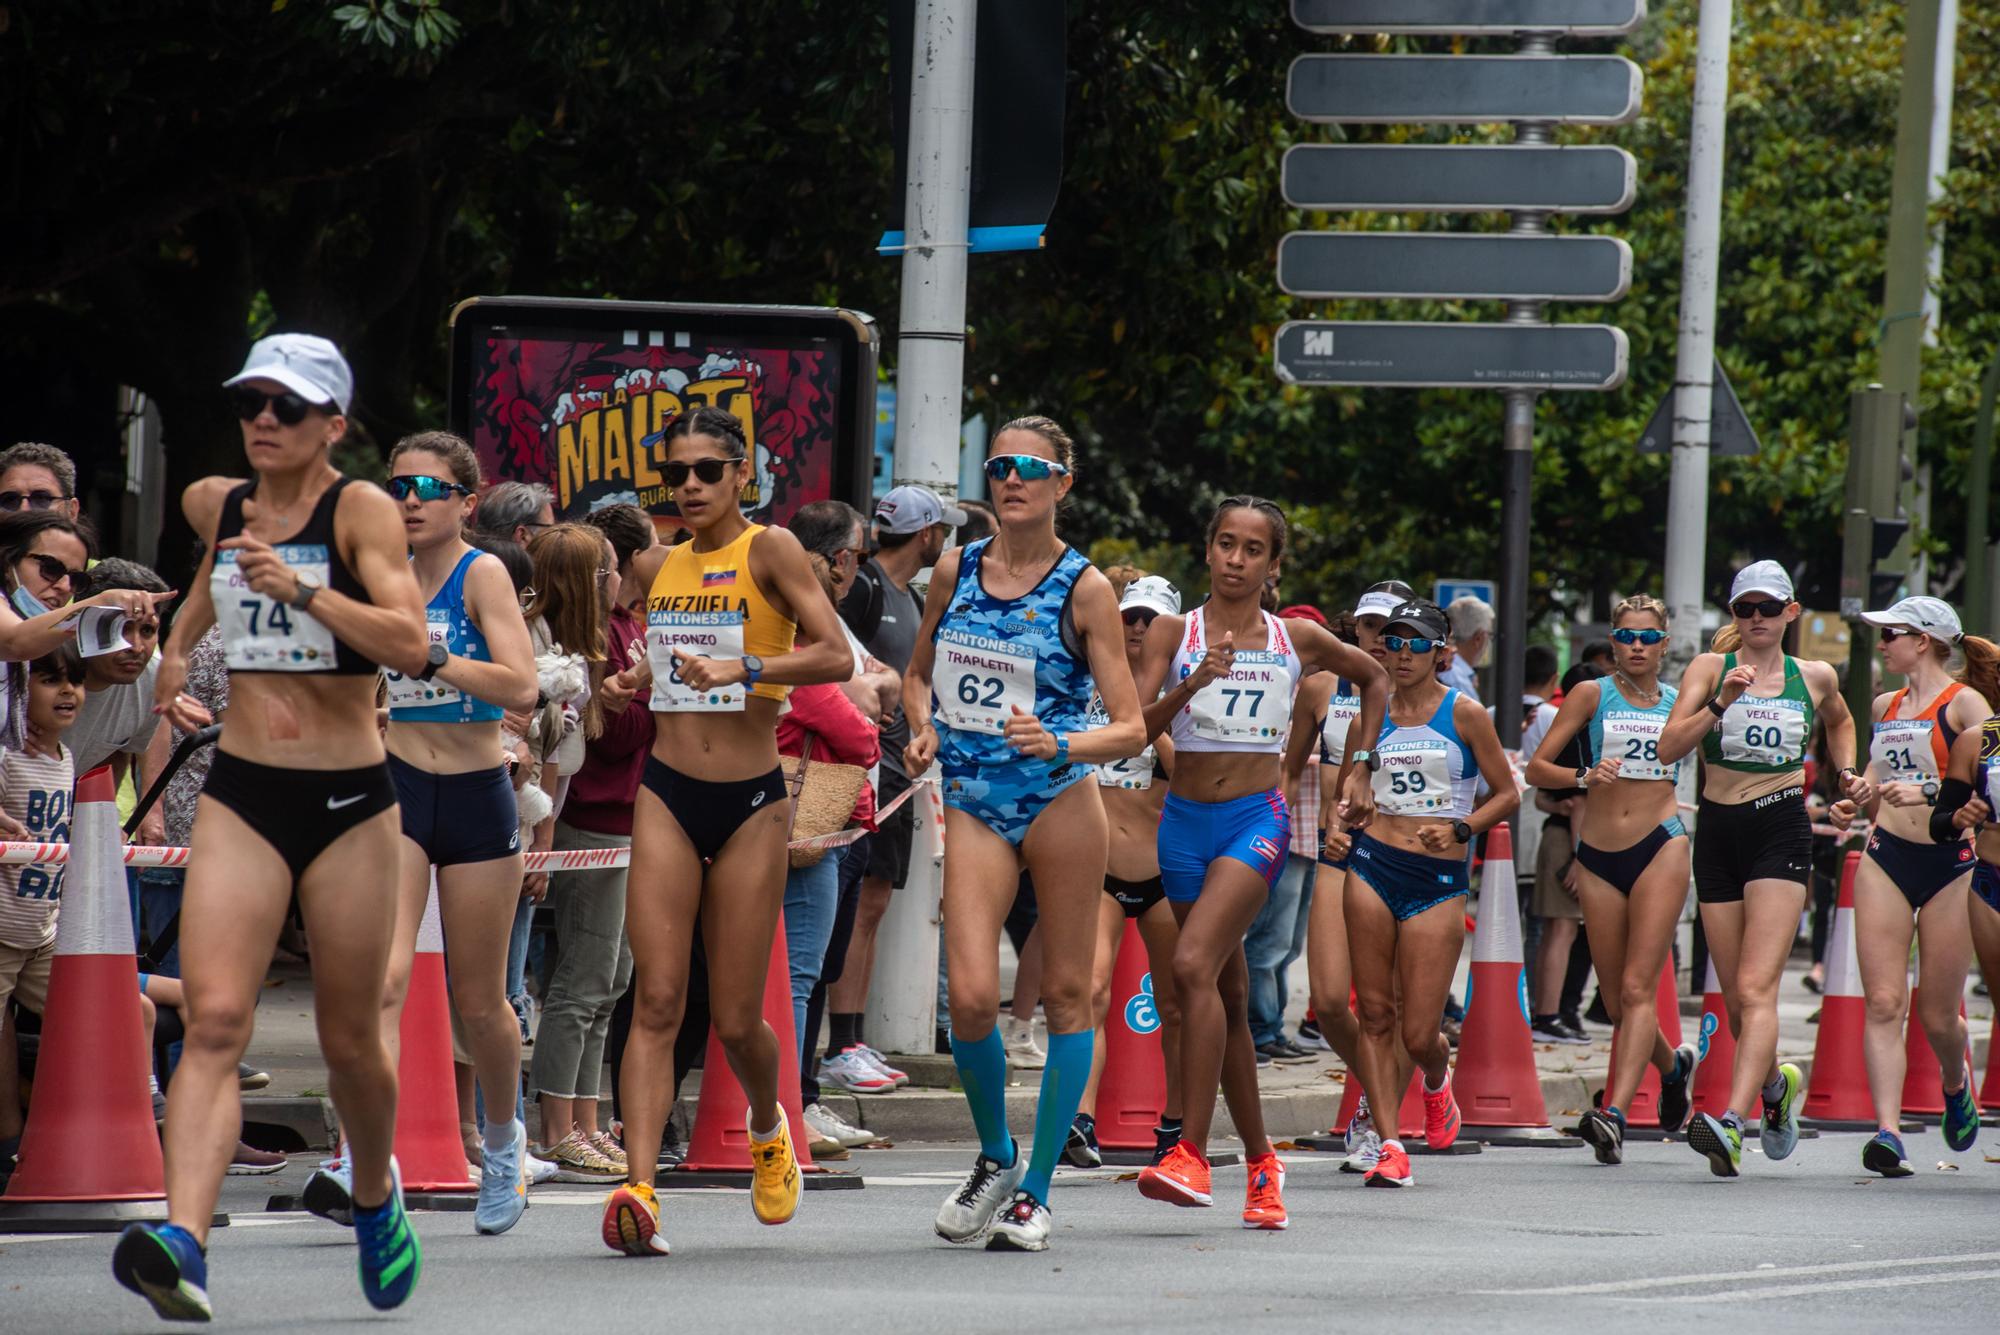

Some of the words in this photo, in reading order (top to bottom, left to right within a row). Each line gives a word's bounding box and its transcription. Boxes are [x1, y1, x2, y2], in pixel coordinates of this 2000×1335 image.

[602, 387, 627, 410] LA
[557, 376, 757, 512] MALDTA
[239, 599, 293, 636] 74
[649, 612, 739, 625] CANTONES23
[658, 633, 717, 646] ALFONZO
[942, 628, 1035, 658] CANTONES23
[946, 650, 1015, 674] TRAPLETTI
[1261, 671, 1274, 683] N.
[958, 673, 1005, 710] 62
[1221, 688, 1265, 718] 77
[1746, 709, 1780, 721] VEALE
[1612, 724, 1660, 735] SANCHEZ
[1745, 724, 1782, 749] 60
[1383, 755, 1422, 767] PONCIO
[1624, 738, 1659, 762] 28
[1885, 747, 1918, 771] 31
[1390, 770, 1426, 795] 59
[1755, 793, 1782, 810] NIKE
[1783, 786, 1804, 800] PRO
[1356, 847, 1371, 860] GUA
